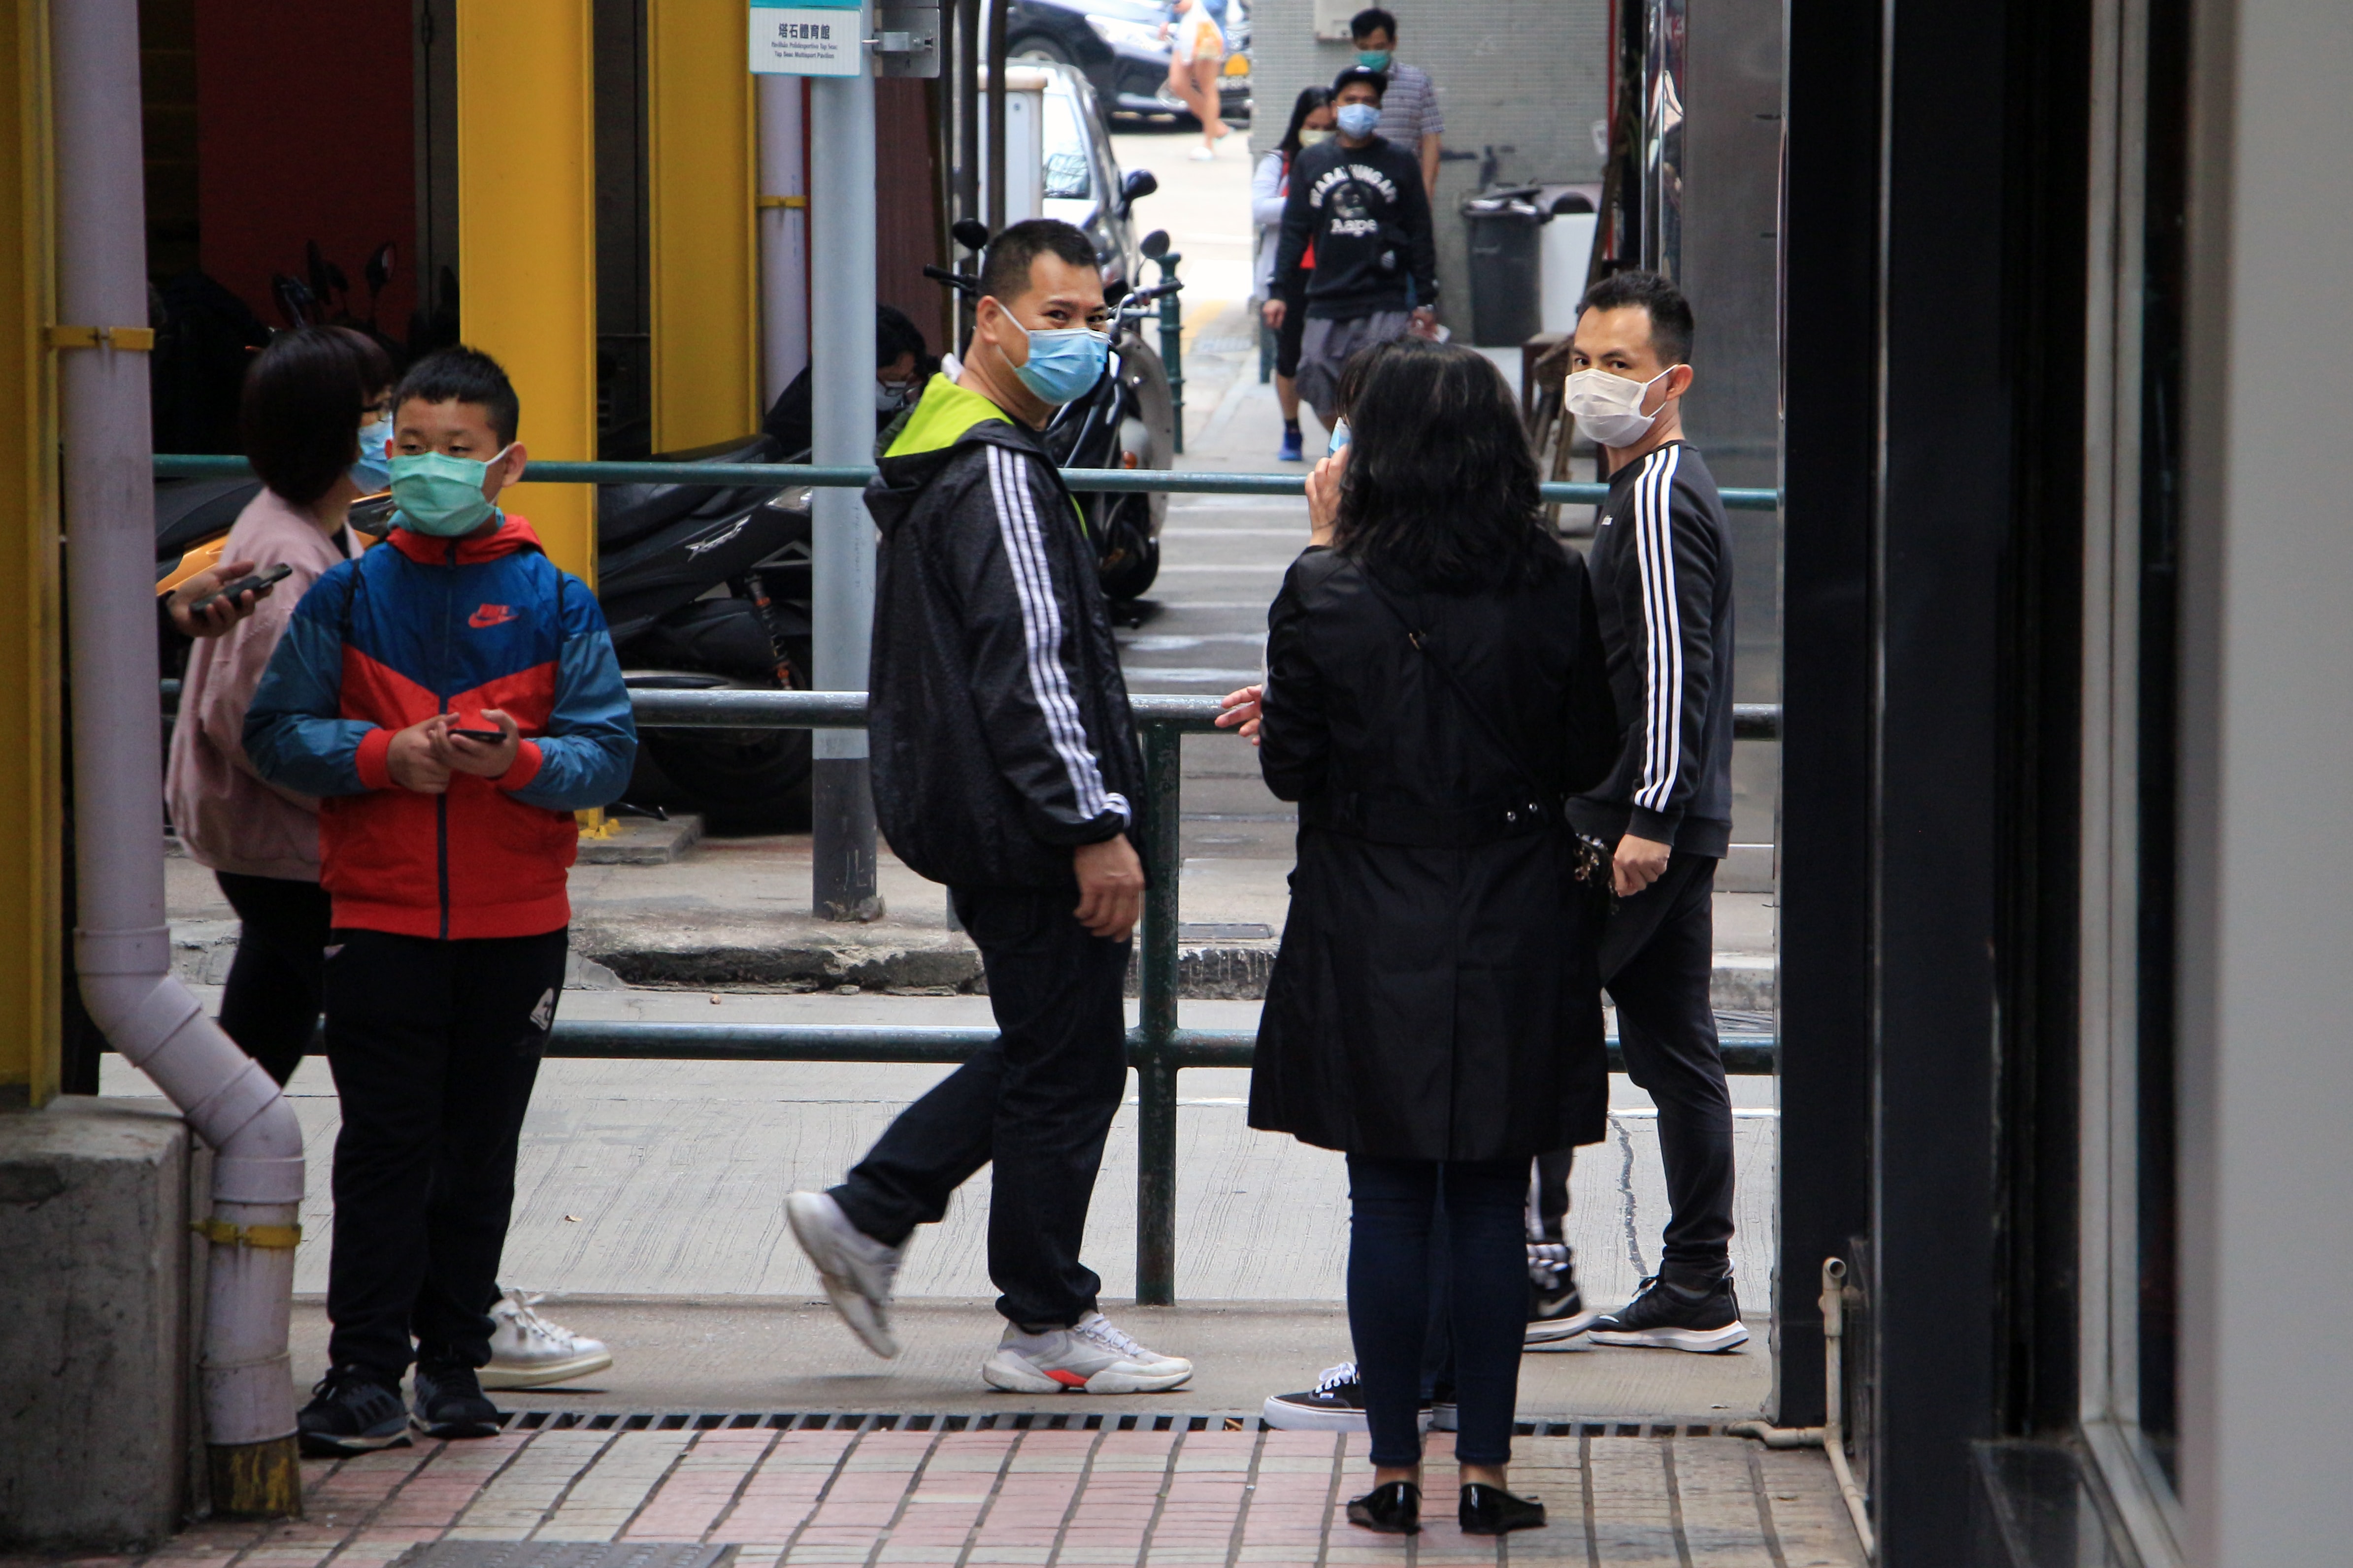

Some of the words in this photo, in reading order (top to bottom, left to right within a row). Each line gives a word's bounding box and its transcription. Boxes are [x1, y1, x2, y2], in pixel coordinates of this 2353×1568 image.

[778, 23, 830, 39] 塔石體育館
